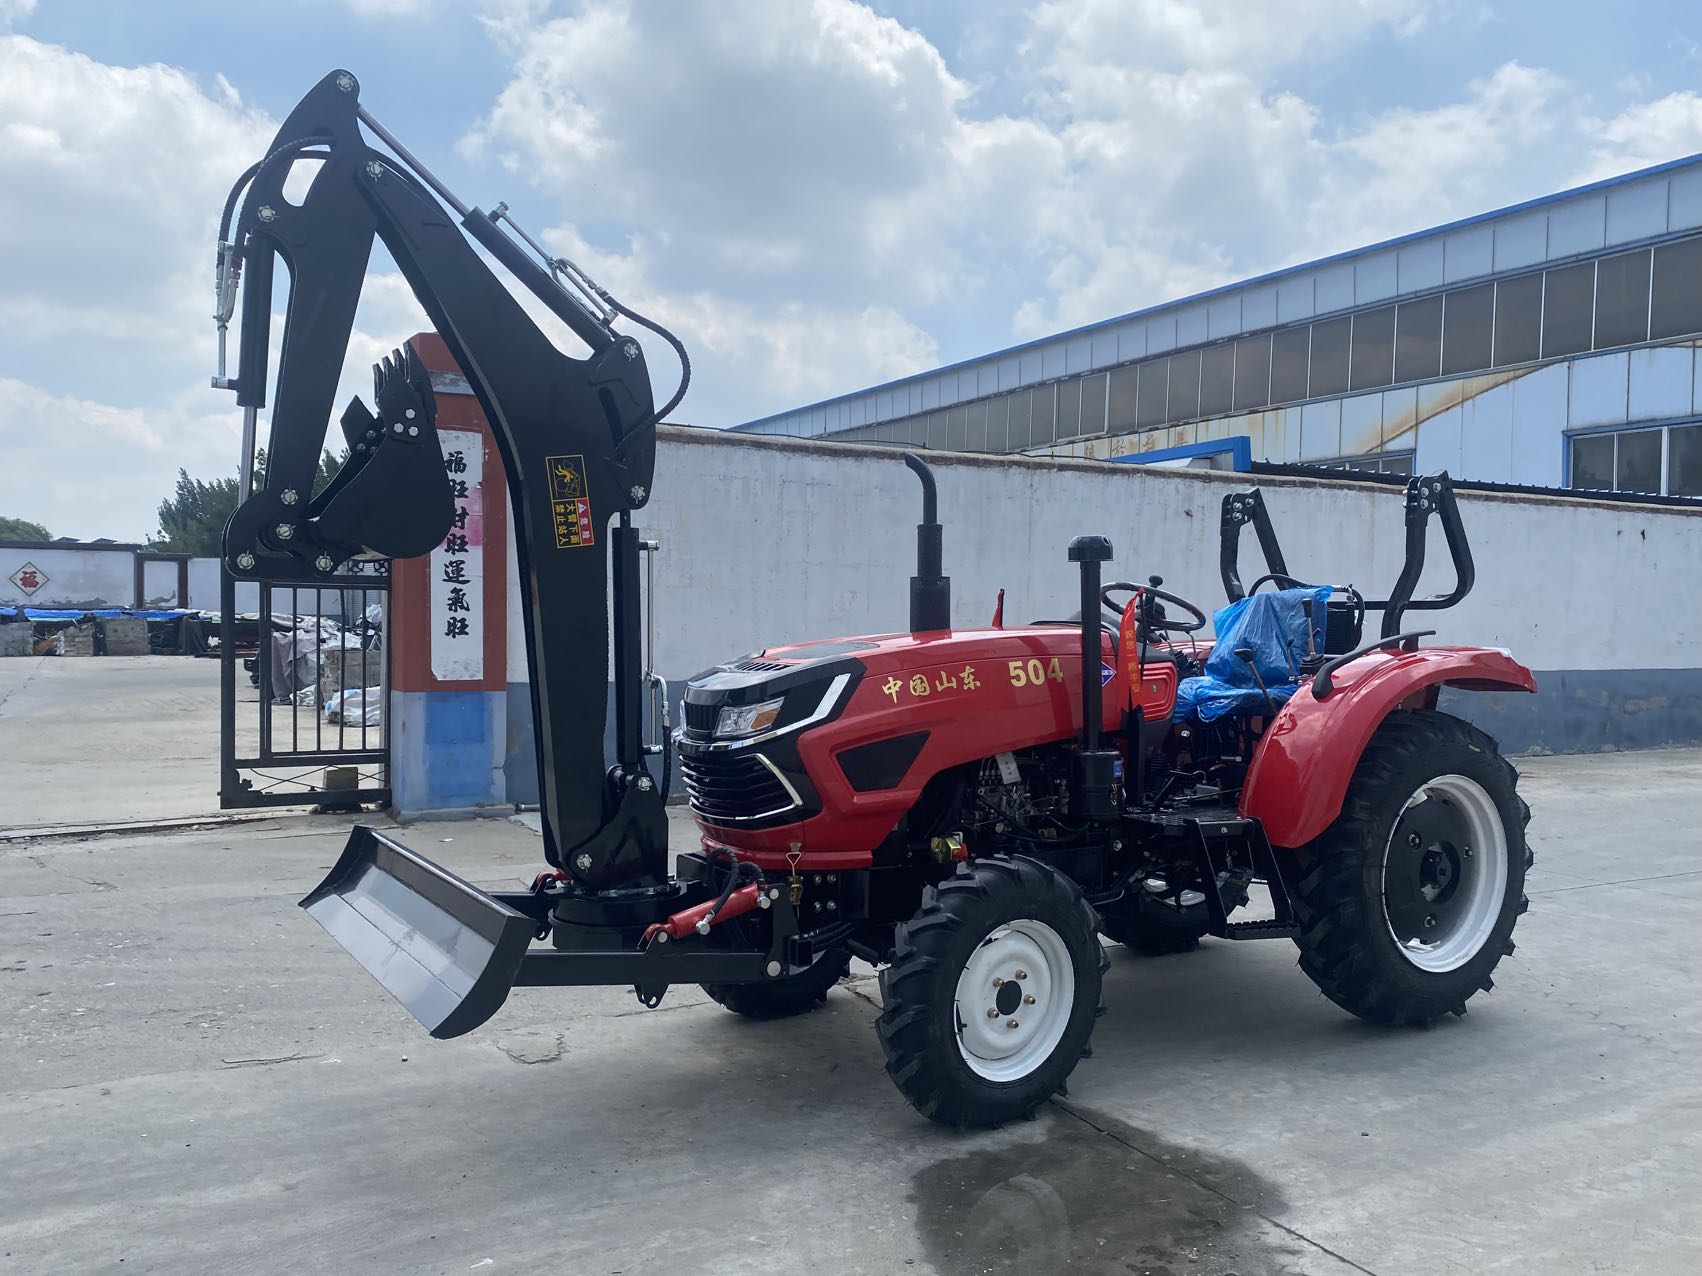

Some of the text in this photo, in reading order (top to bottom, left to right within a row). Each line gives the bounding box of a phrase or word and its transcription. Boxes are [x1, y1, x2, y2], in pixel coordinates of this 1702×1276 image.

[555, 503, 569, 545] 禁止站人
[580, 517, 591, 539] 危险
[882, 658, 1064, 704] 中国山东 504
